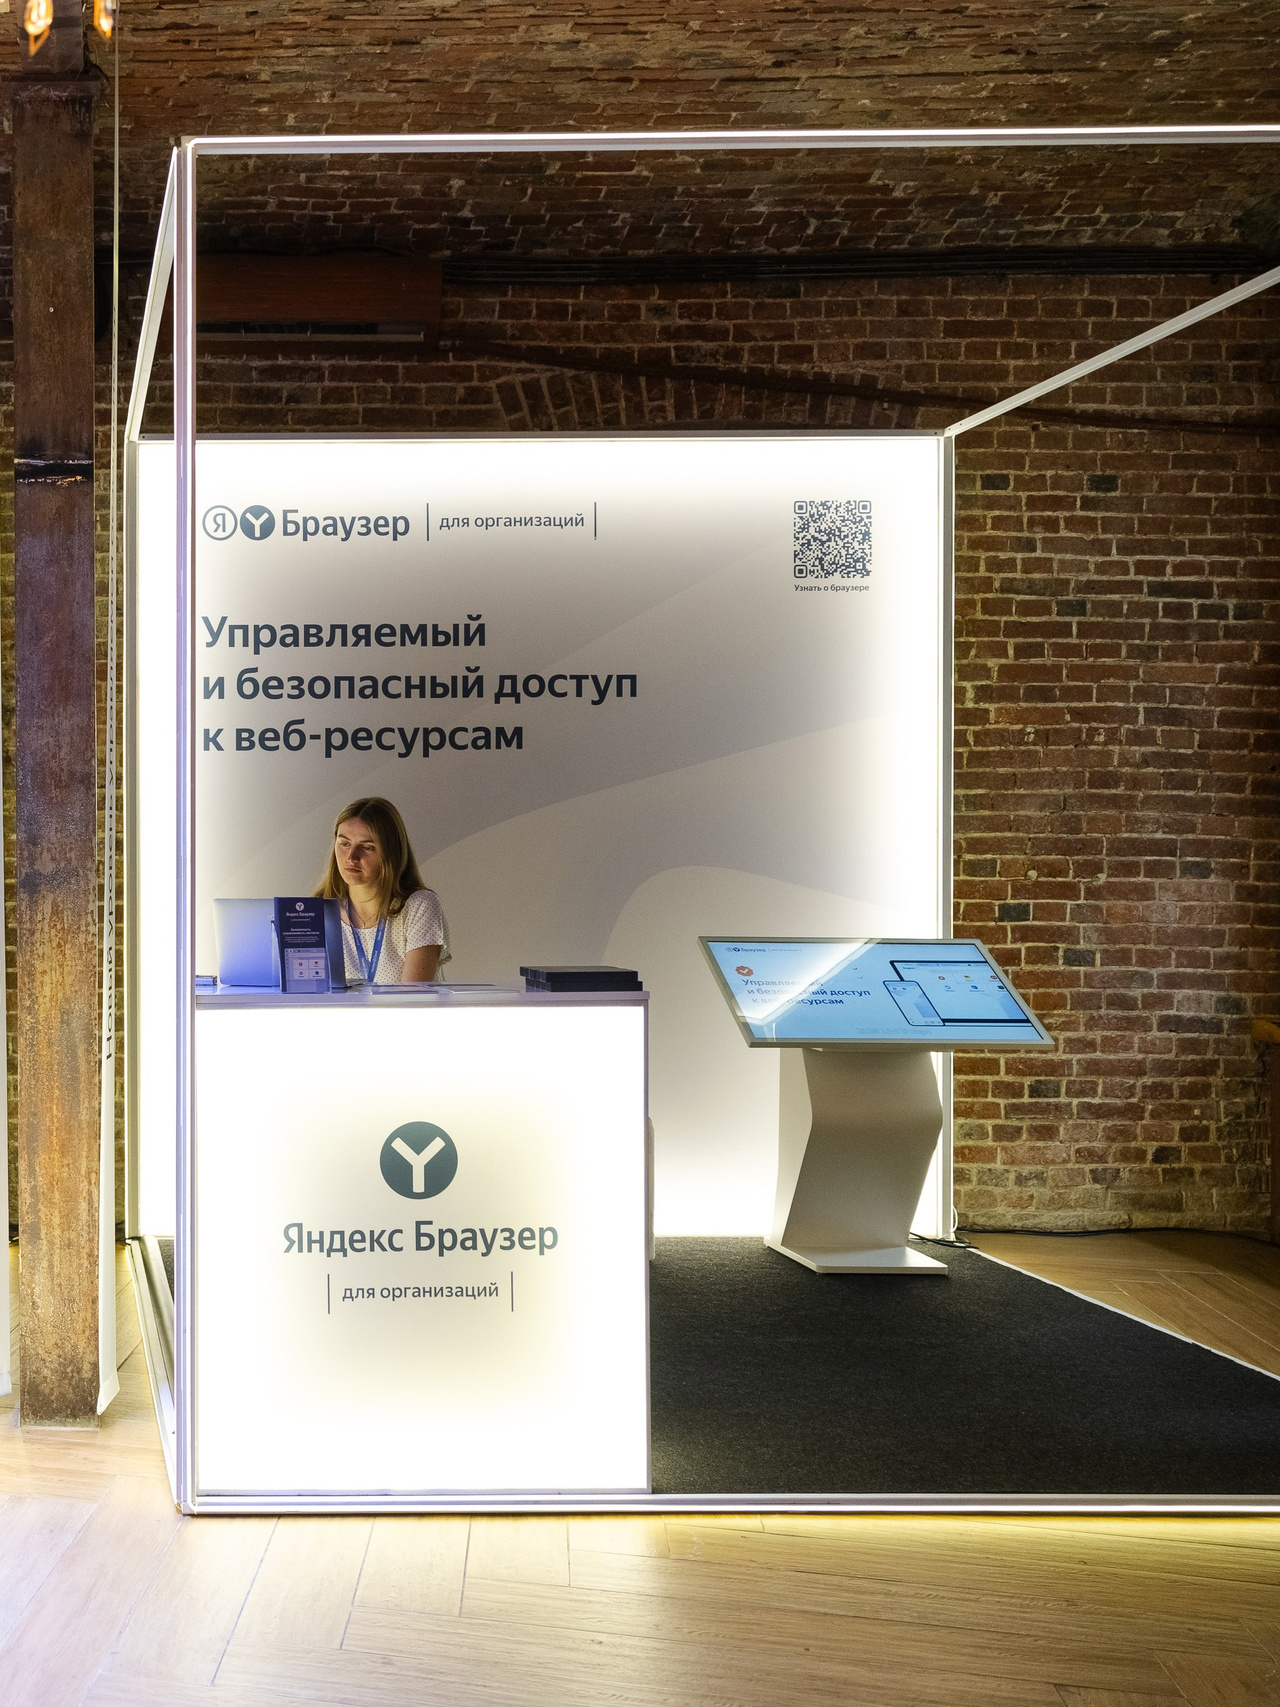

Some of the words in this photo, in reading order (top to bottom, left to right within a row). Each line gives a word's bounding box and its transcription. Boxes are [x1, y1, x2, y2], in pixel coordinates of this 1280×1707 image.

[282, 508, 411, 542] Браузер
[439, 515, 470, 530] для
[474, 512, 585, 531] организаций
[794, 584, 822, 592] Узнать
[830, 583, 870, 593] браузере
[201, 614, 487, 655] Управляемый
[202, 677, 225, 700] и
[236, 666, 484, 700] безопасный
[494, 672, 638, 706] доступ
[202, 728, 225, 752] к
[235, 719, 524, 759] веб-ресурсам
[829, 989, 871, 998] доступ
[283, 1222, 405, 1258] Яндекс
[415, 1220, 559, 1257] Браузер
[342, 1286, 376, 1302] для
[380, 1282, 500, 1302] организаций
